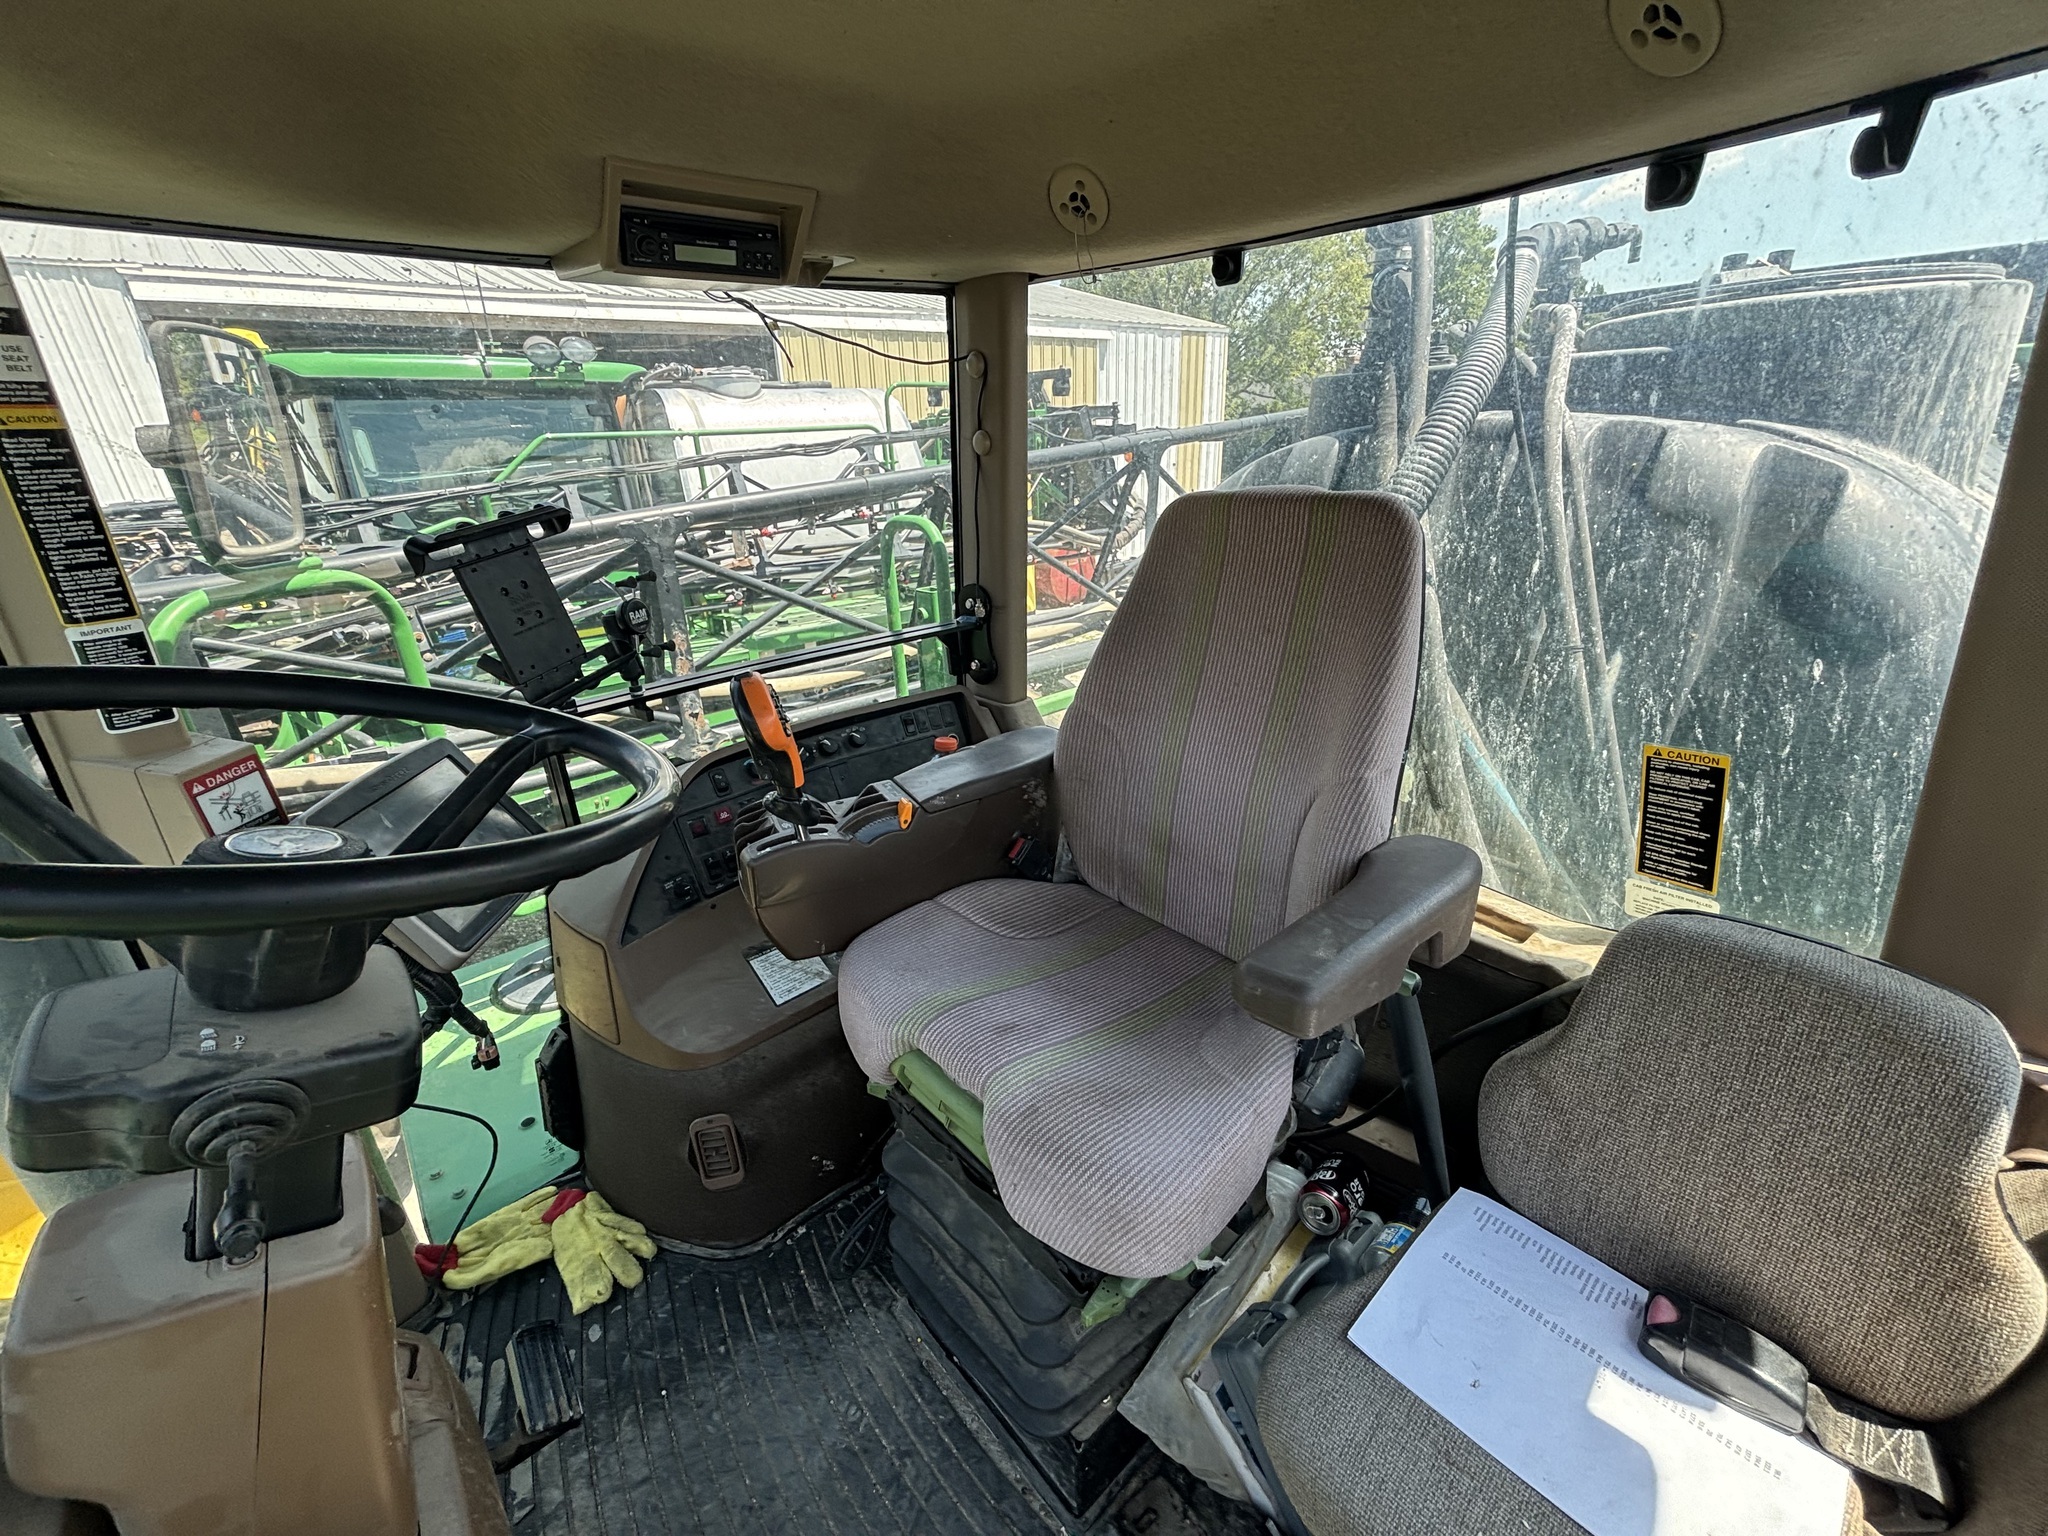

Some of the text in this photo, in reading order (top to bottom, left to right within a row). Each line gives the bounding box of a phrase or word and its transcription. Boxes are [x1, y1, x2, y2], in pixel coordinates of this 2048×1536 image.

[1, 345, 24, 353] USE
[1, 354, 29, 362] SEAT
[6, 364, 33, 373] BELT
[6, 415, 57, 424] CAUTION
[629, 608, 648, 621] RAM
[79, 624, 133, 637] IMPORTANT
[1667, 750, 1720, 766] CAUTION
[205, 760, 257, 788] DANGER
[1643, 885, 1659, 893] FRESH
[1668, 892, 1685, 900] FILTER
